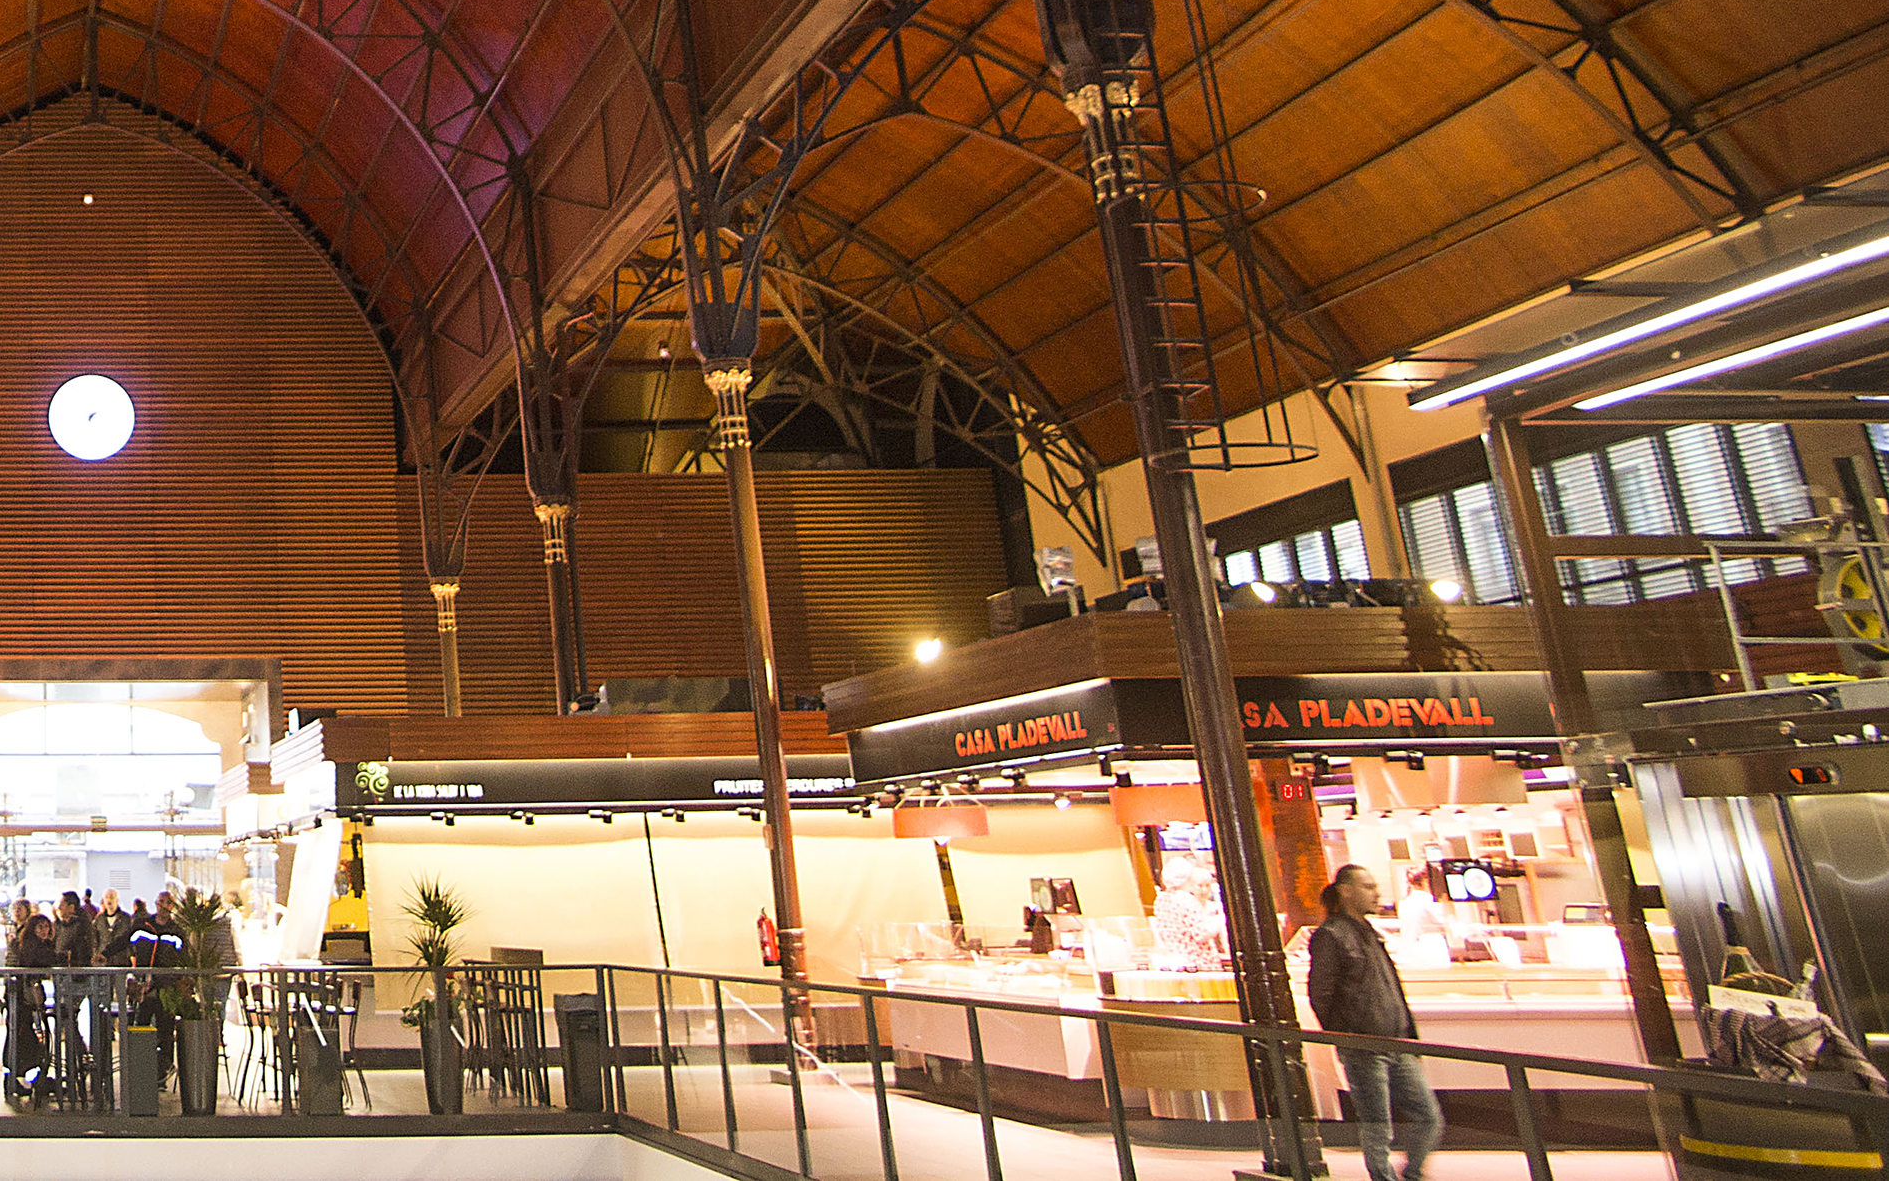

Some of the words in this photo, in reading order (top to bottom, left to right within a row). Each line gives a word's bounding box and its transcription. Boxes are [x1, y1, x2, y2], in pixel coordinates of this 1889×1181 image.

[1298, 697, 1495, 729] PLADEVALL
[954, 727, 997, 758] CASA
[996, 710, 1088, 752] PLADEVALL
[713, 779, 766, 794] FRUITES
[1281, 783, 1305, 802] 01
